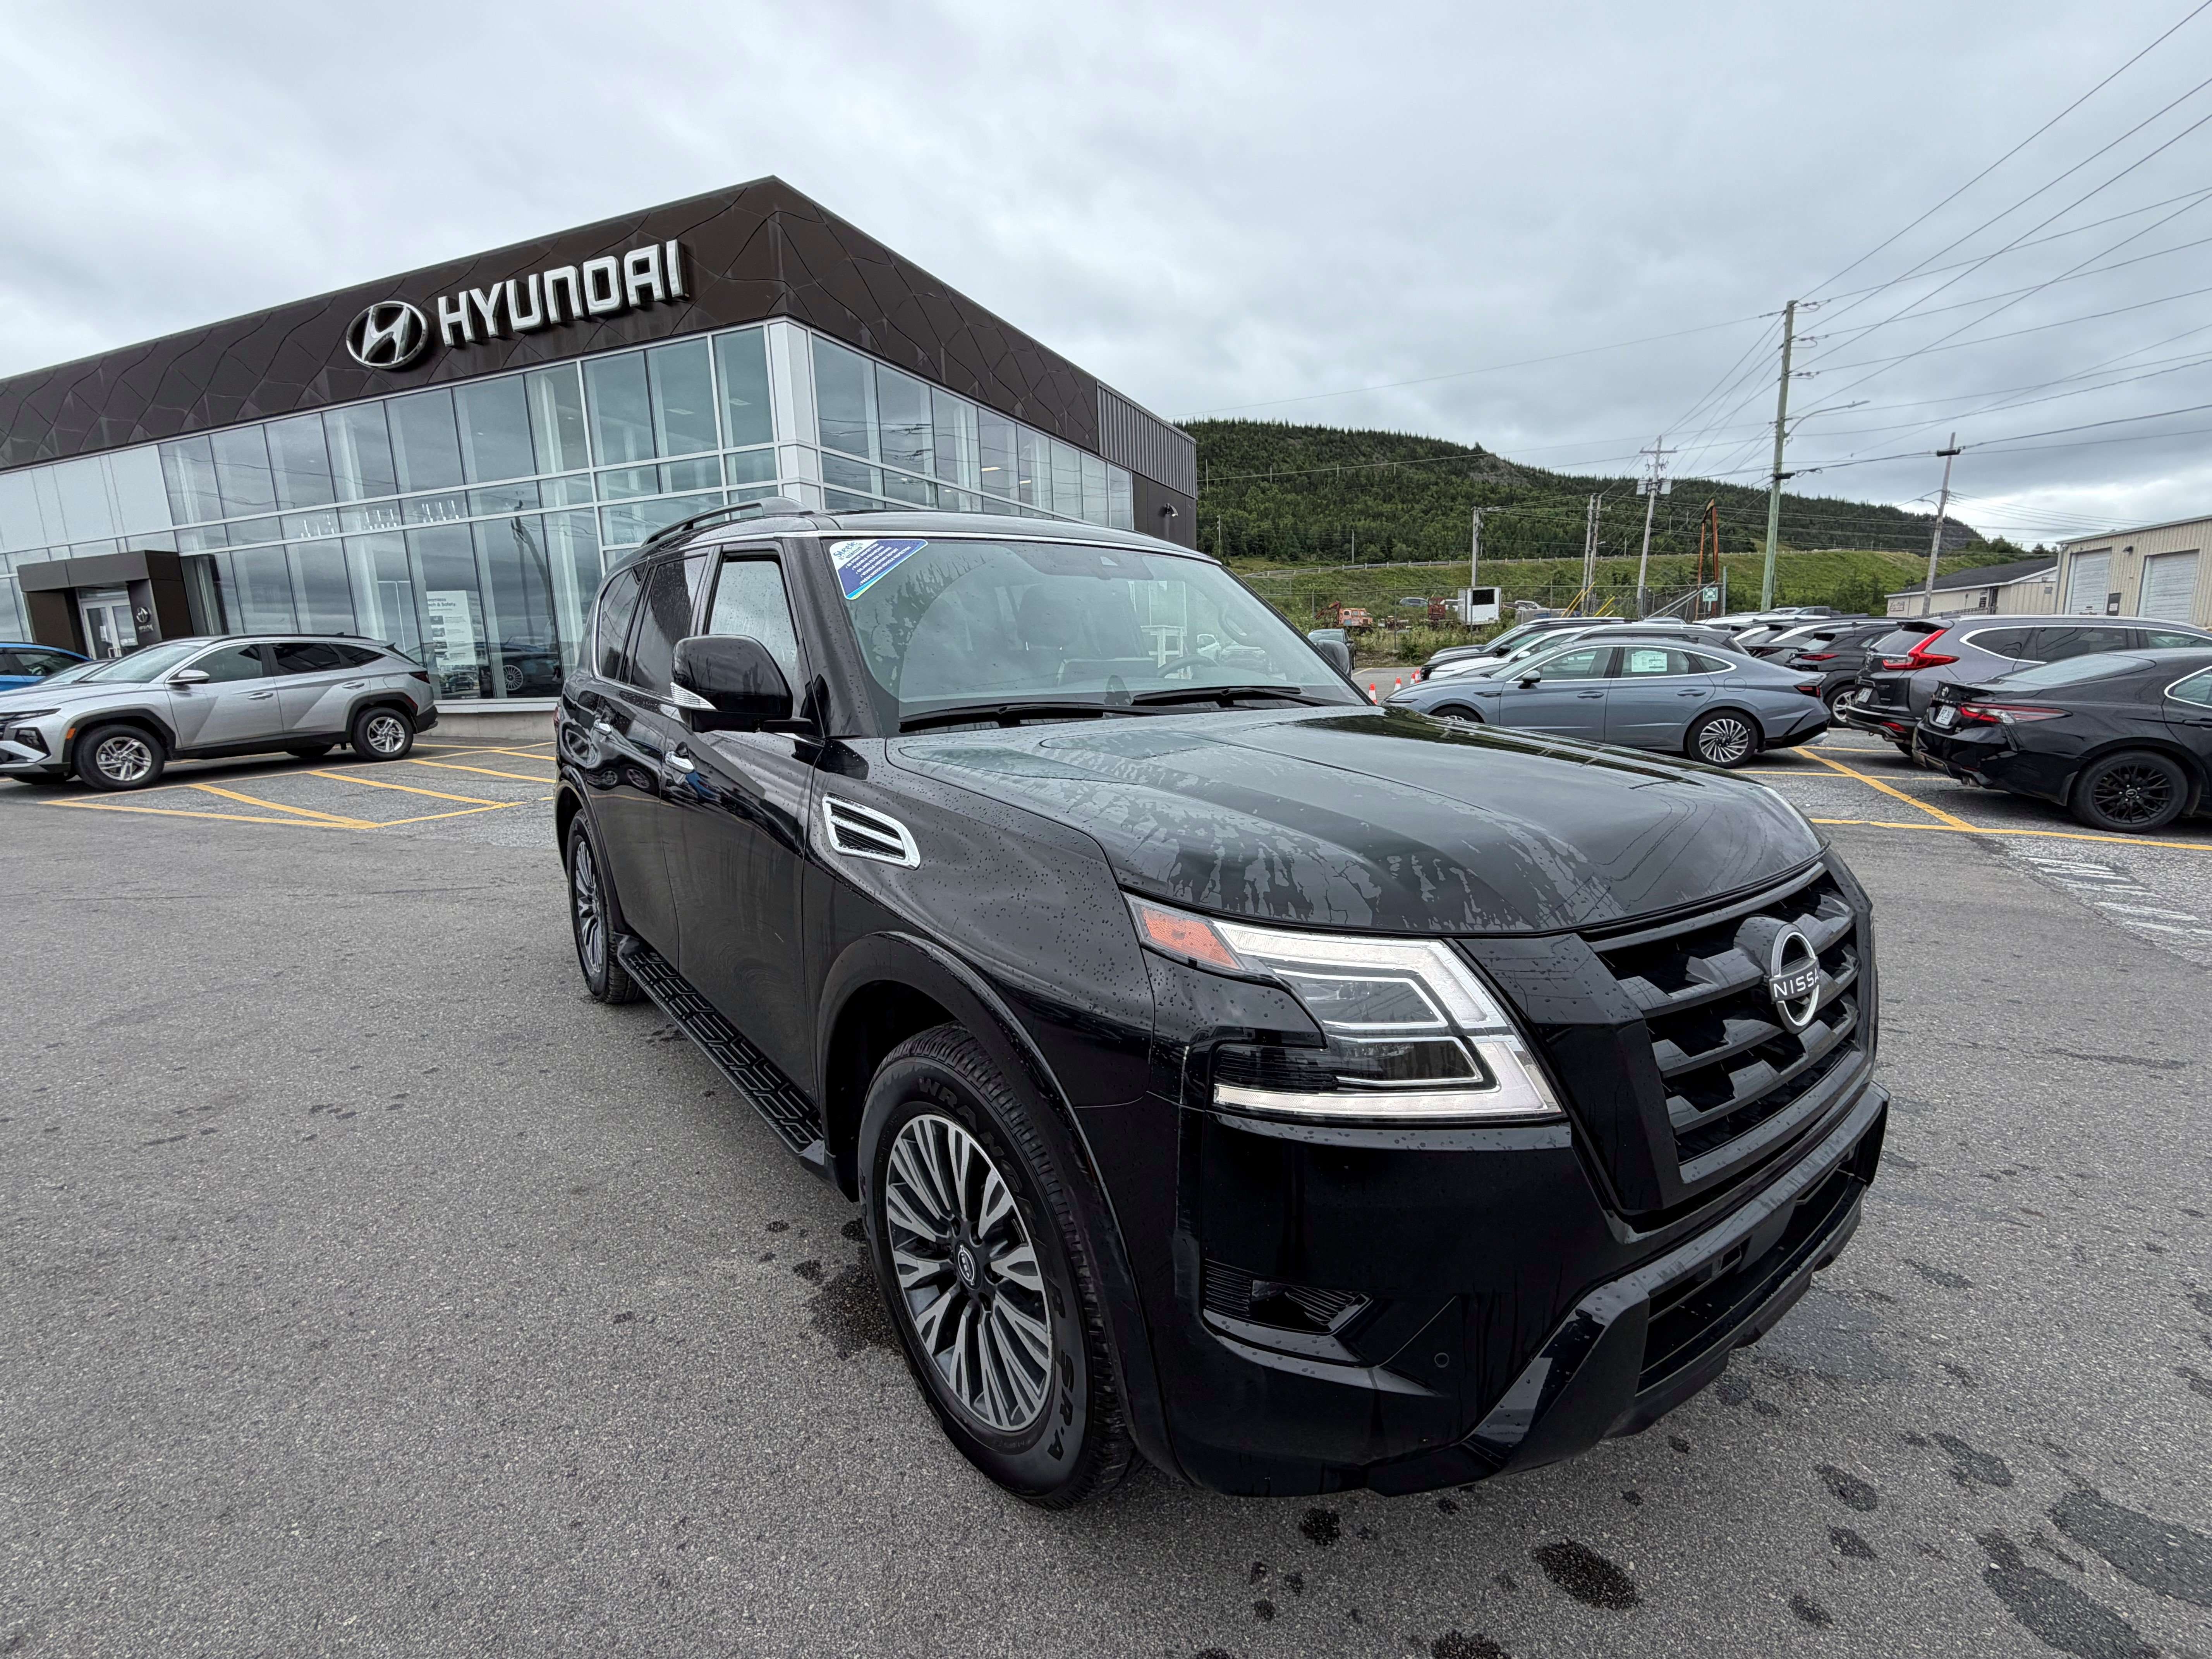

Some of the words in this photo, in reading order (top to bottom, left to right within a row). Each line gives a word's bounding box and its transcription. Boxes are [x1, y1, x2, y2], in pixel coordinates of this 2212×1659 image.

[438, 239, 689, 348] HYUNDAI
[833, 542, 857, 557] Steele
[1773, 968, 1819, 998] NISSA
